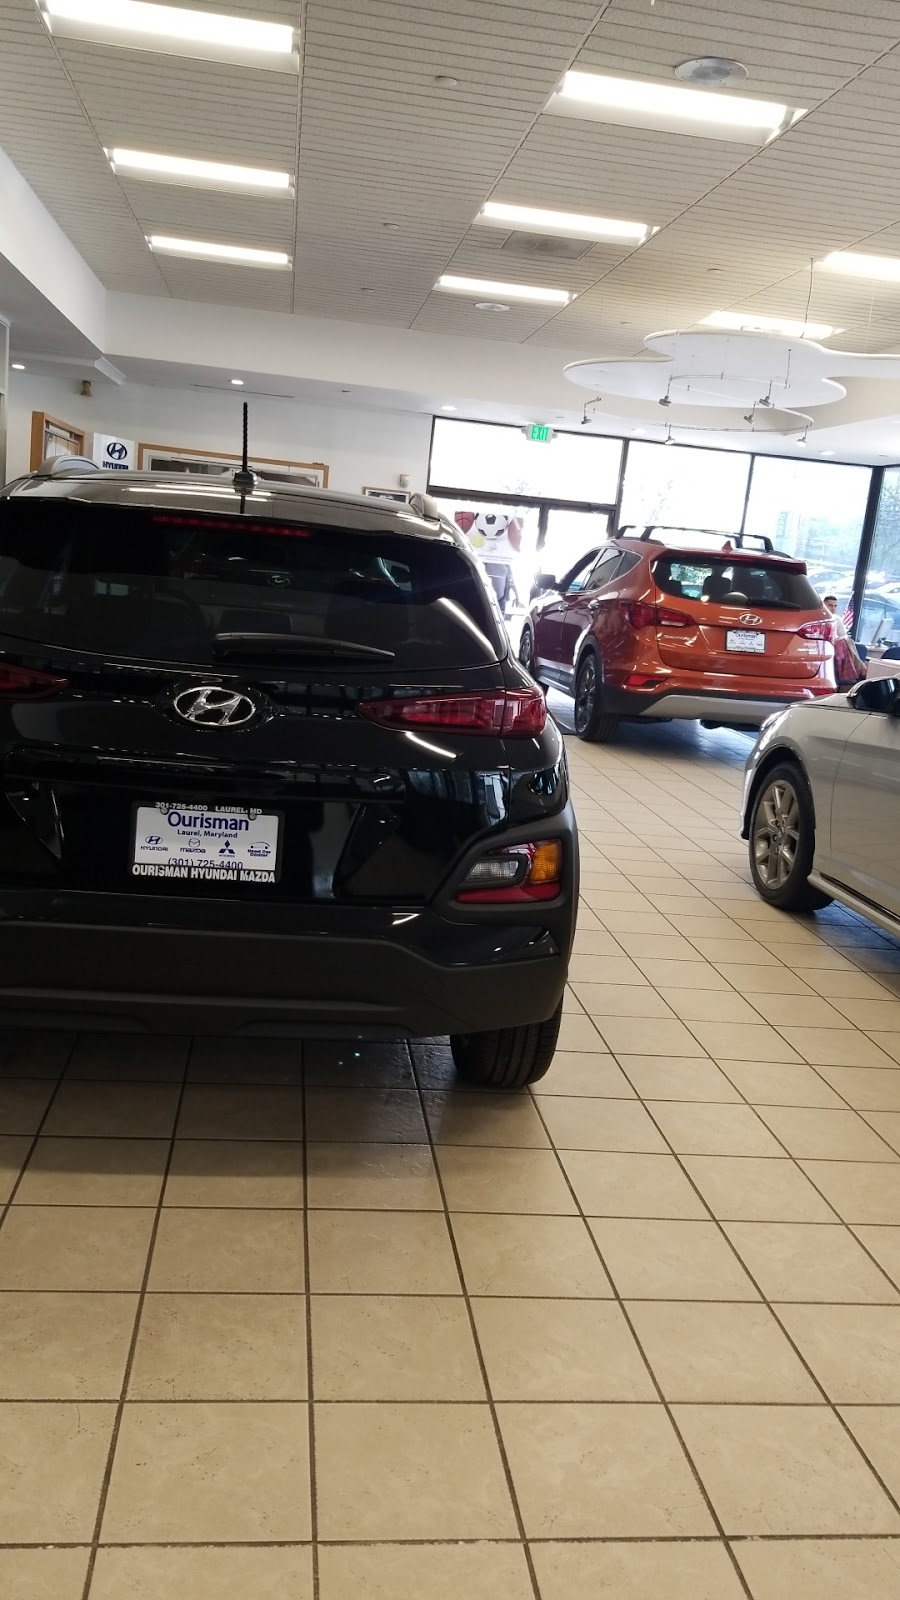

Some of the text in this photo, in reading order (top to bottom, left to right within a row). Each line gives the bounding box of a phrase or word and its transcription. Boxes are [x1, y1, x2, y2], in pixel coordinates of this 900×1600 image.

[531, 425, 550, 441] EXIT
[155, 802, 208, 811] 301-725-4400
[167, 811, 249, 831] Ourisman
[177, 829, 238, 839] Laurel, Maryland
[132, 864, 276, 883] OURISMAN HYUNDAI MAZDA
